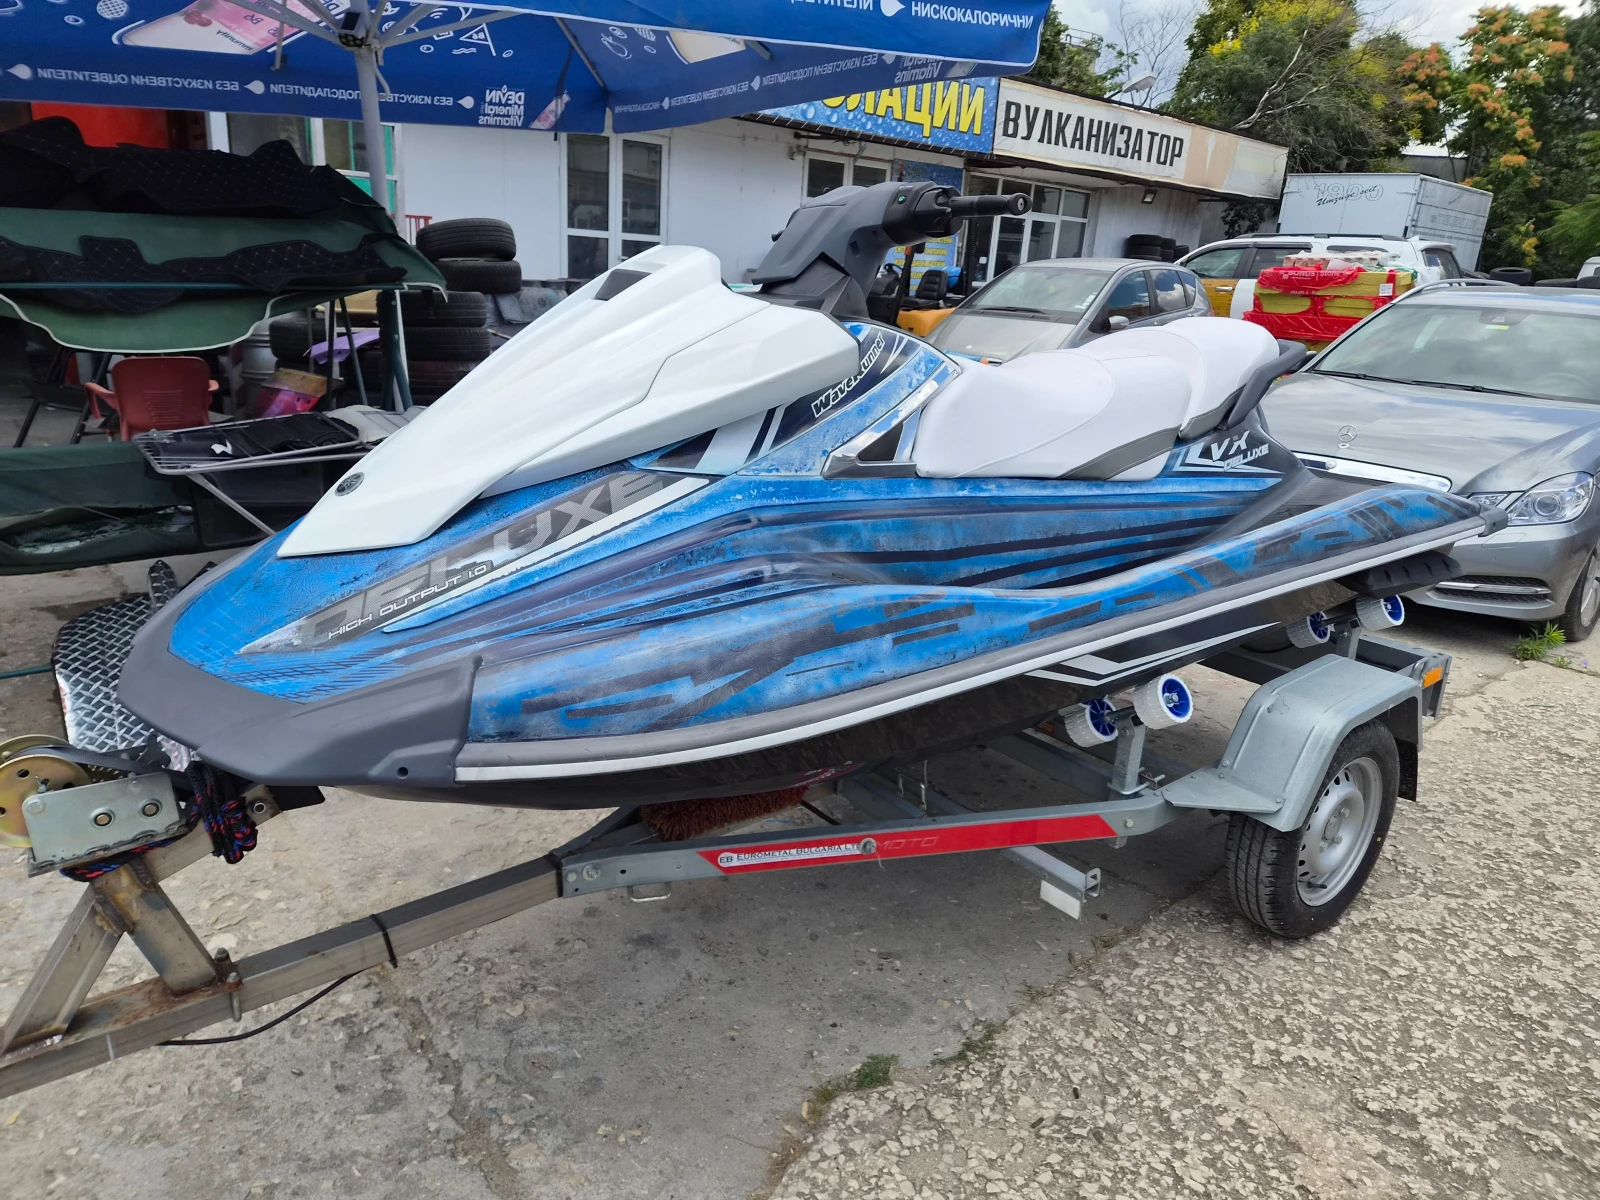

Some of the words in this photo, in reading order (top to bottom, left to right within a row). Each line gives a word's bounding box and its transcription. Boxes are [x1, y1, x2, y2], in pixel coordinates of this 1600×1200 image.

[912, 4, 1034, 29] НИСКОКАЛОРИЧНИ
[1002, 100, 1184, 167] ВУЛКАНИЗАТОР
[1316, 192, 1355, 206] Umzüge
[1360, 185, 1377, 195] seit
[1211, 430, 1250, 462] VX
[1224, 443, 1269, 470] DELUXE
[328, 613, 373, 640] HIGH
[379, 575, 462, 615] OUTPUT
[468, 564, 487, 582] 1.0
[719, 856, 734, 864] EB
